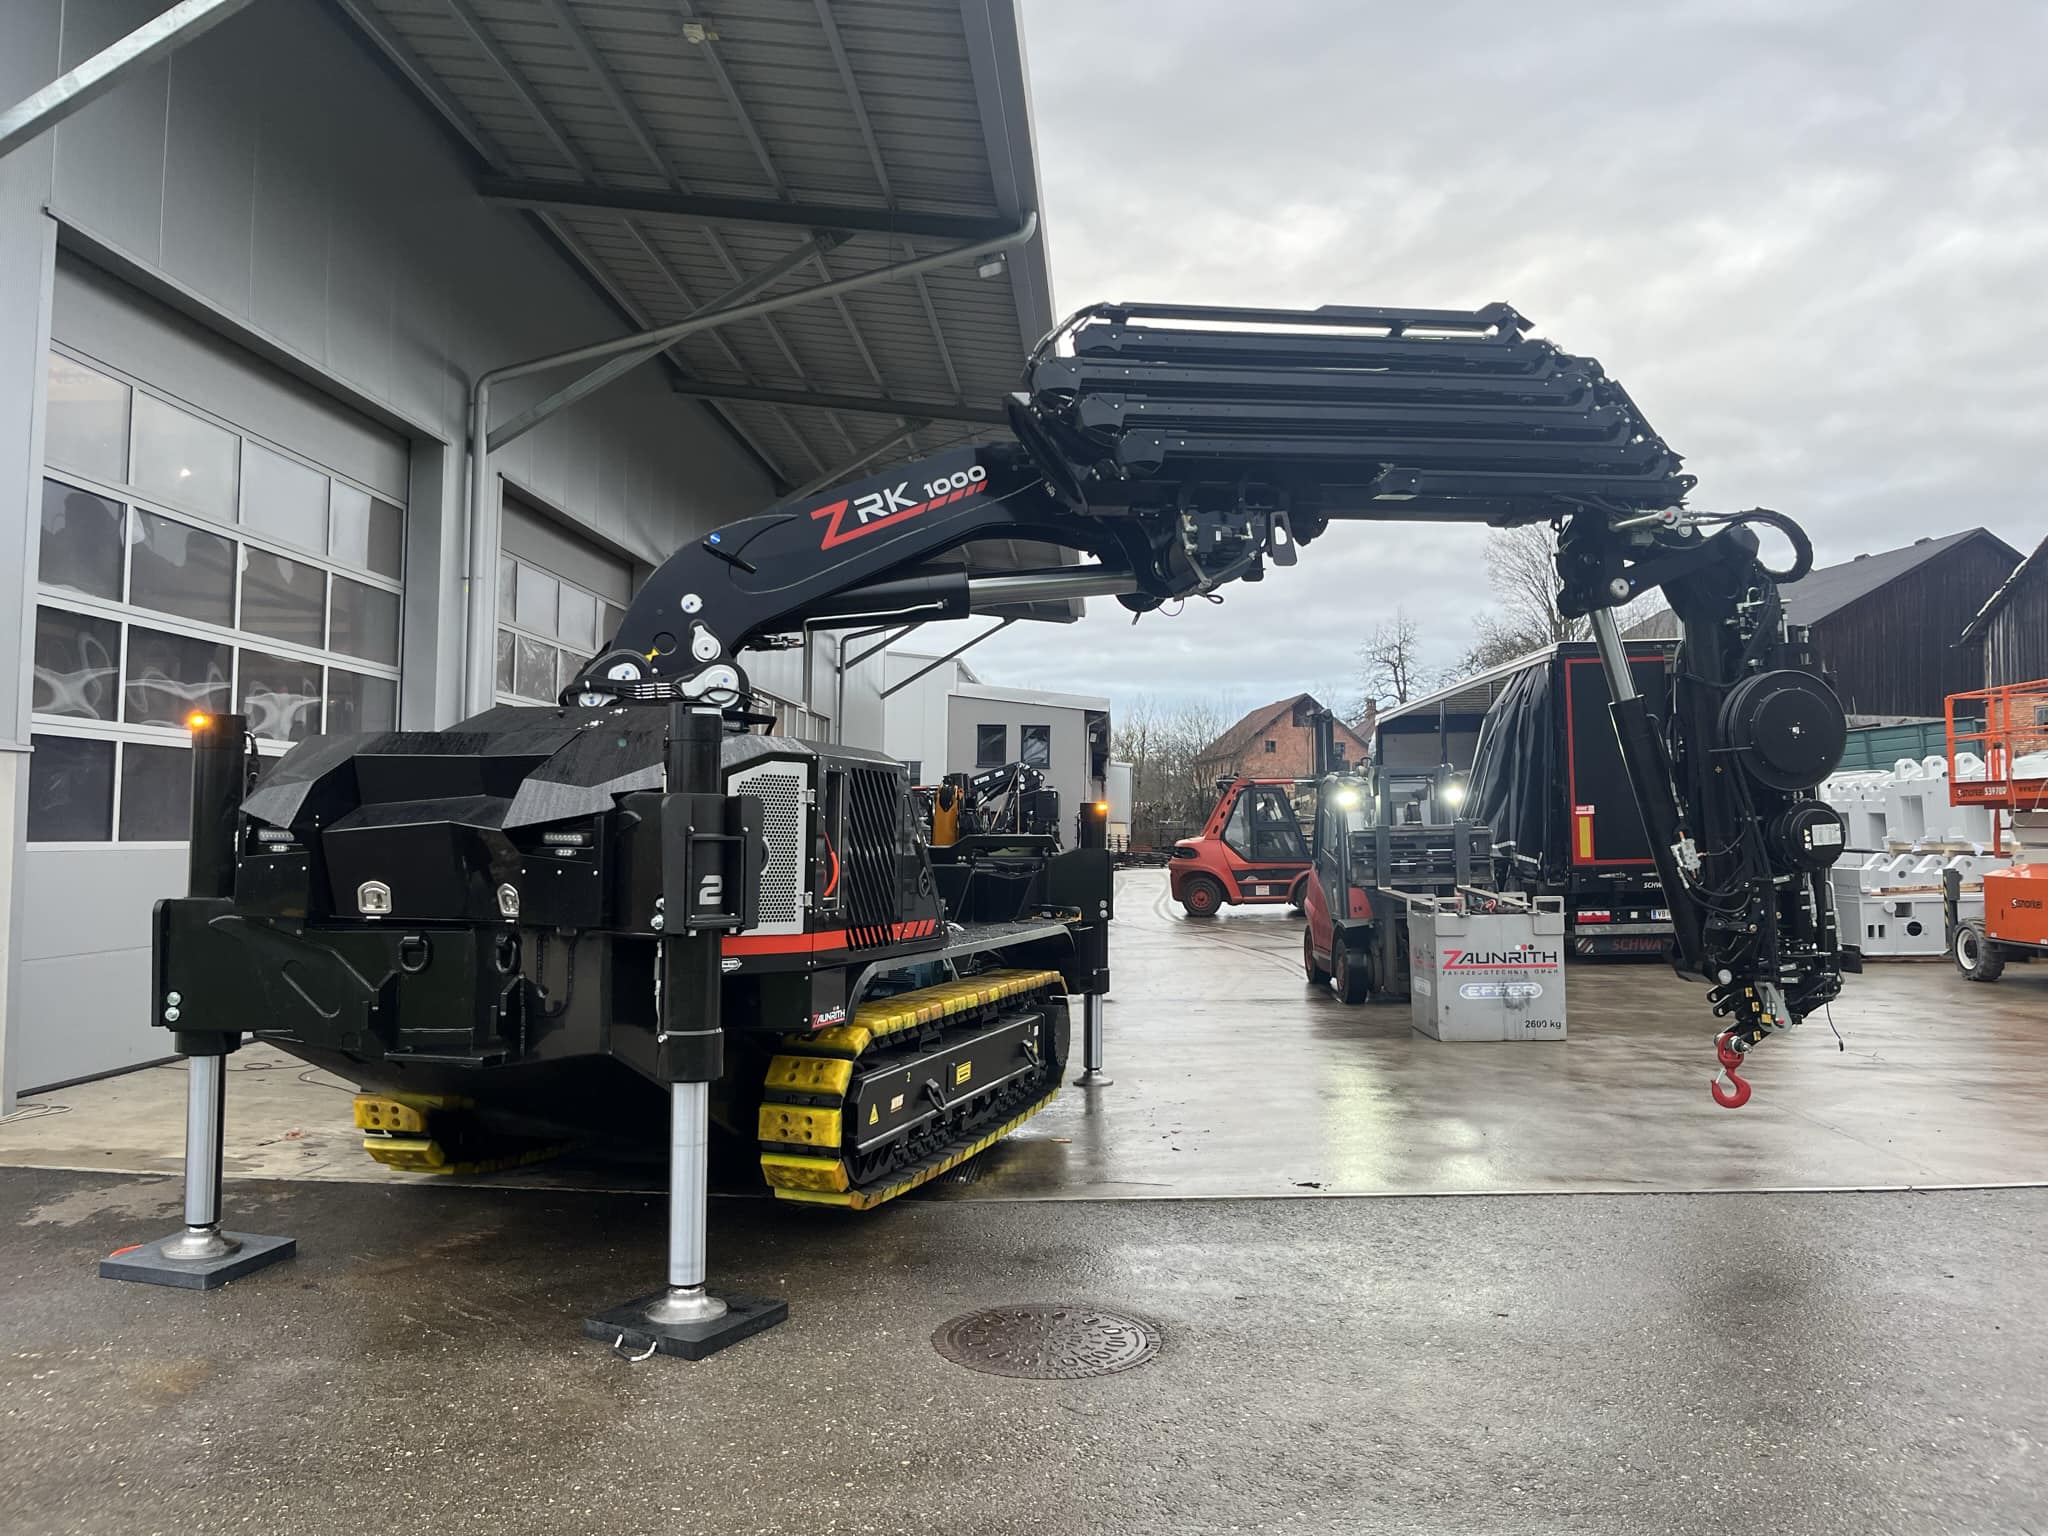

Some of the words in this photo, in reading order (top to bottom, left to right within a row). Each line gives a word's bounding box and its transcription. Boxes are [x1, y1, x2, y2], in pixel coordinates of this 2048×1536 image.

[810, 481, 919, 551] ZRK
[923, 465, 987, 499] 1000
[699, 875, 723, 905] 2
[1442, 948, 1558, 970] ZAUNRITH
[1466, 984, 1536, 997] EFFER
[812, 1008, 846, 1028] ZAUNRITH
[1550, 1020, 1562, 1029] kg
